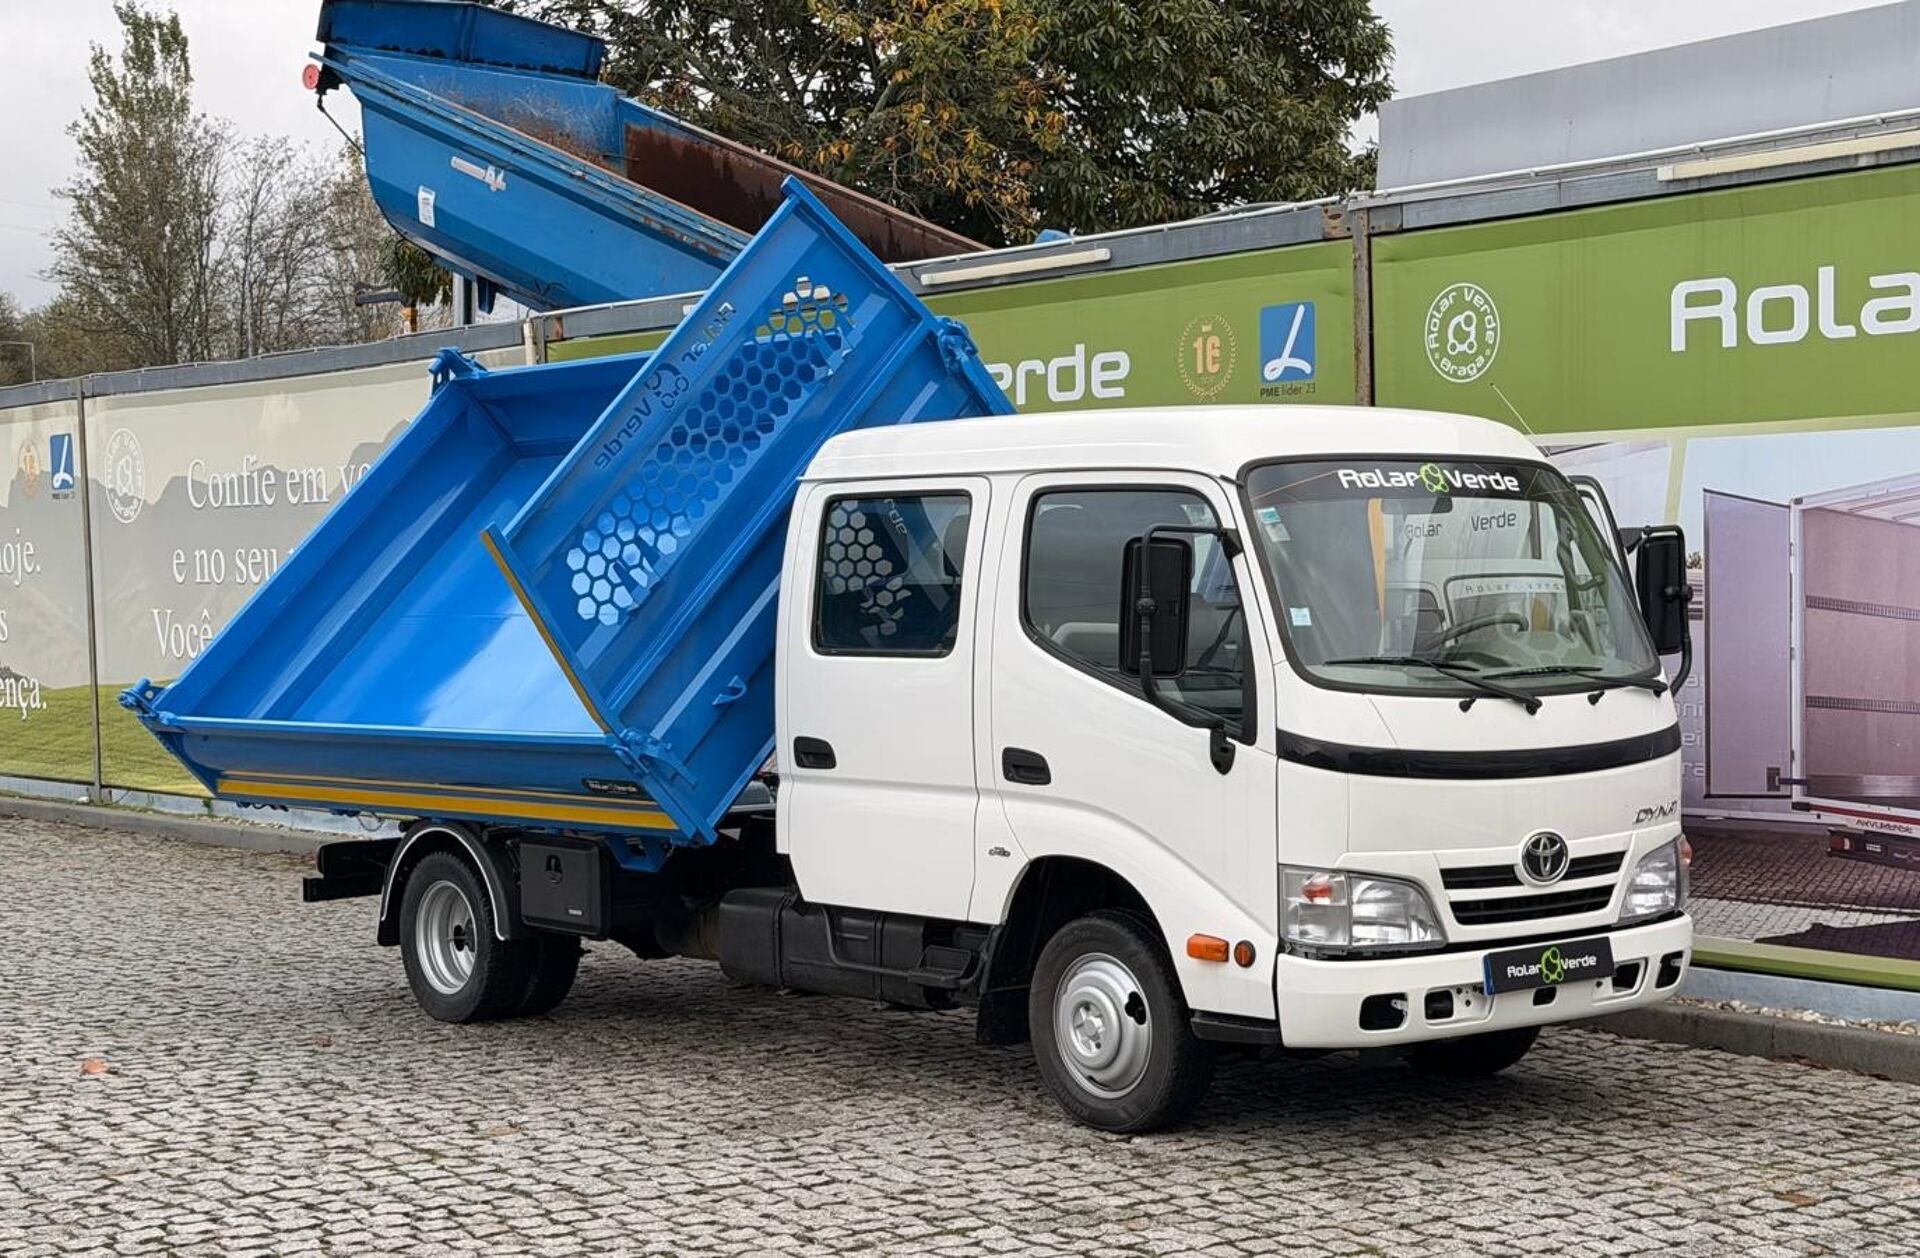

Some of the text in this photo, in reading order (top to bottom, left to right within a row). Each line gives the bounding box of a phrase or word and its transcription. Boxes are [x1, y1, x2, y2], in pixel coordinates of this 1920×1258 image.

[1428, 287, 1496, 349] Rolar Verde
[1670, 265, 1920, 352] Rola
[984, 343, 1131, 405] erde
[1440, 355, 1485, 377] Braga
[1259, 386, 1281, 399] PME
[186, 454, 277, 508] Confie
[285, 466, 329, 504] em
[339, 462, 372, 494] vo
[1337, 468, 1520, 492] Rolar Verde
[1470, 510, 1517, 532] Verde
[0, 527, 41, 586] oje.
[172, 548, 187, 583] e
[194, 548, 226, 584] no
[150, 607, 214, 659] Você
[1506, 954, 1597, 979] Rolar Verde
